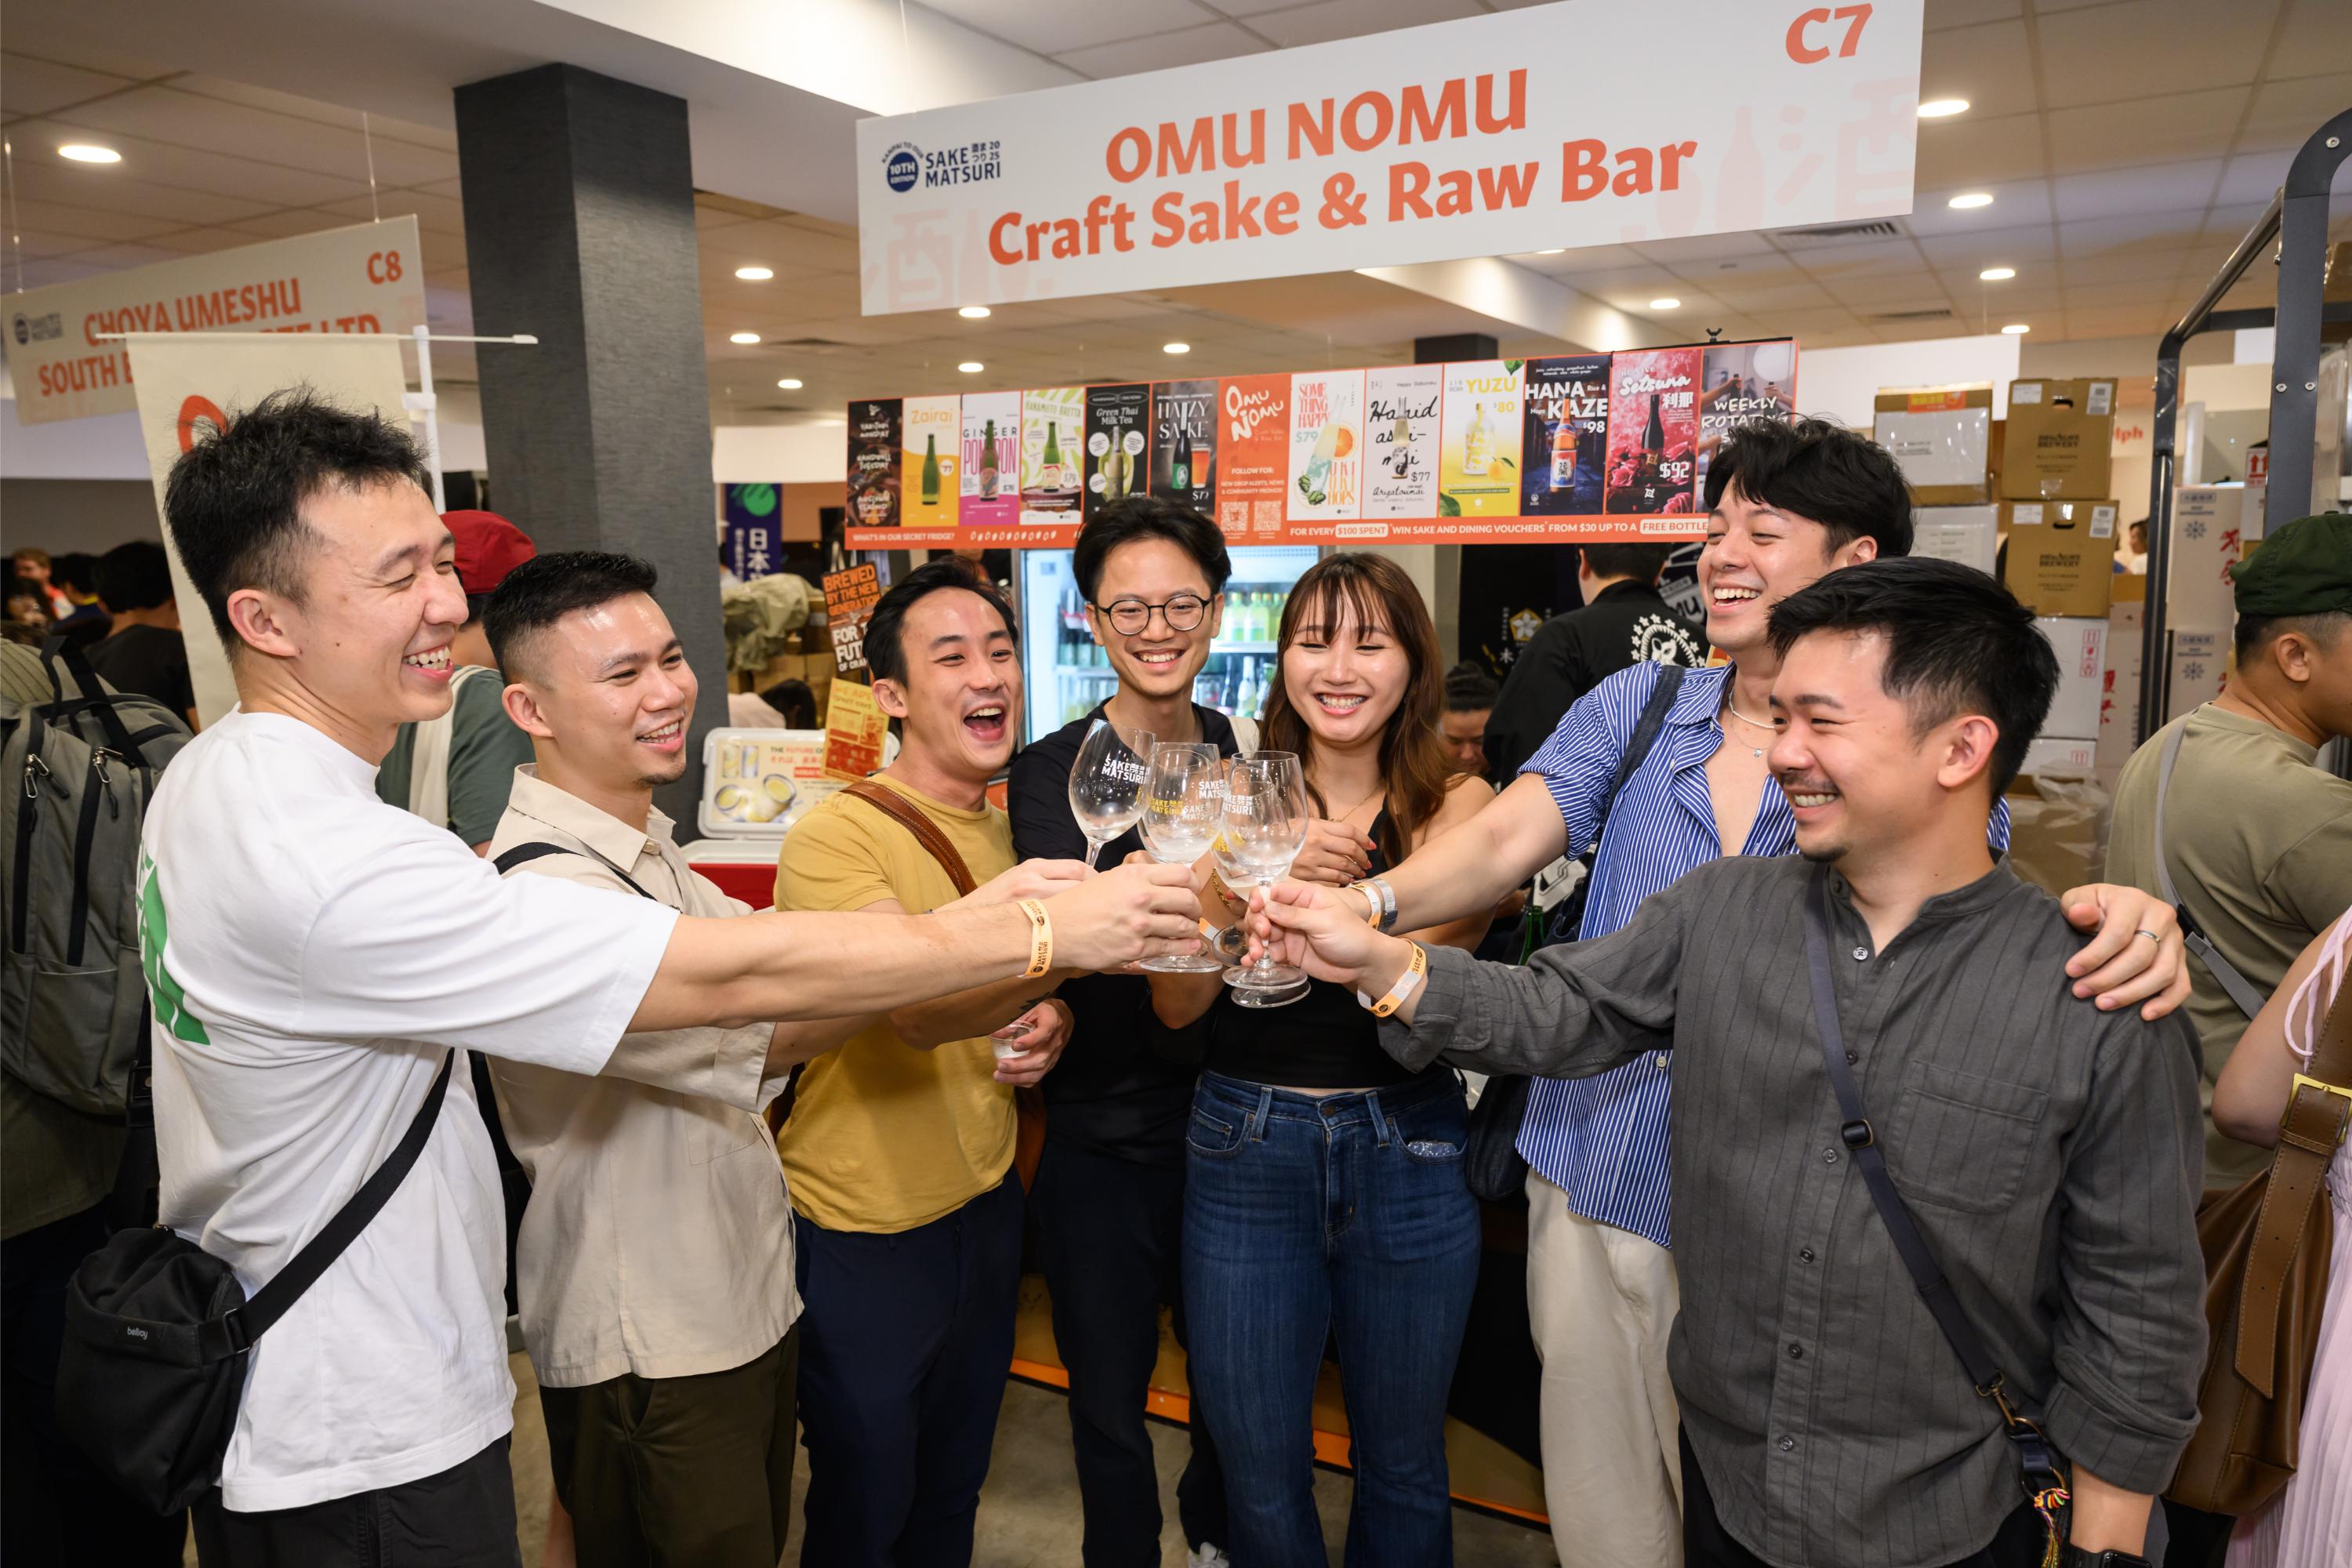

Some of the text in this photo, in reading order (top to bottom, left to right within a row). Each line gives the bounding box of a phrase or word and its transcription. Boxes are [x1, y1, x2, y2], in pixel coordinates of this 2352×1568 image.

[1785, 3, 1873, 64] C7
[1106, 68, 1527, 183] OMU NOMU
[926, 147, 968, 169] SAKE
[890, 162, 916, 176] 10TH
[925, 162, 1001, 188] MATSURI
[988, 139, 1699, 265] Craft Sake & Raw Bar
[366, 251, 402, 285] C8
[84, 301, 172, 347] CHOYA
[176, 277, 301, 332] UMESHU
[38, 354, 117, 396] SOUTH
[1298, 383, 1327, 396] SOME
[1466, 376, 1516, 394] YUZU
[1525, 381, 1585, 400] HANA
[1620, 375, 1691, 396] Setsuna
[1096, 406, 1138, 417] Green Thai
[1158, 401, 1210, 419] HAZY
[1299, 398, 1328, 414] THING
[1548, 398, 1608, 419] KAZE
[1714, 396, 1777, 412] WEEKLY
[911, 408, 953, 425] Zairai
[1298, 413, 1330, 428] HAPPY
[1159, 421, 1208, 439] SAKE
[1583, 421, 1606, 434] $98
[1296, 431, 1318, 443] $79
[1411, 472, 1430, 482] $77
[1660, 461, 1690, 479] $92
[1308, 528, 1334, 536] EVERY
[1413, 525, 1436, 534] SAKE
[1436, 525, 1457, 534] AND
[1459, 524, 1490, 533] DINING
[1548, 524, 1578, 532] FROM
[1579, 522, 1597, 534] $30
[1599, 524, 1613, 532] UP
[1614, 523, 1628, 532] TO
[1629, 523, 1637, 532] A
[1642, 522, 1667, 532] FREE
[1669, 521, 1708, 531] BOTTLE
[825, 564, 875, 590] BREWED
[826, 581, 879, 605] BY THE NEW
[829, 594, 882, 615] GENERATION
[832, 624, 858, 644] FOR
[838, 661, 848, 671] OF
[1104, 757, 1131, 771] SAKE
[1102, 766, 1145, 784] MATSURI
[1199, 779, 1220, 790] SAKE
[1184, 804, 1205, 813] SAKE
[127, 1326, 147, 1340] bellroy
